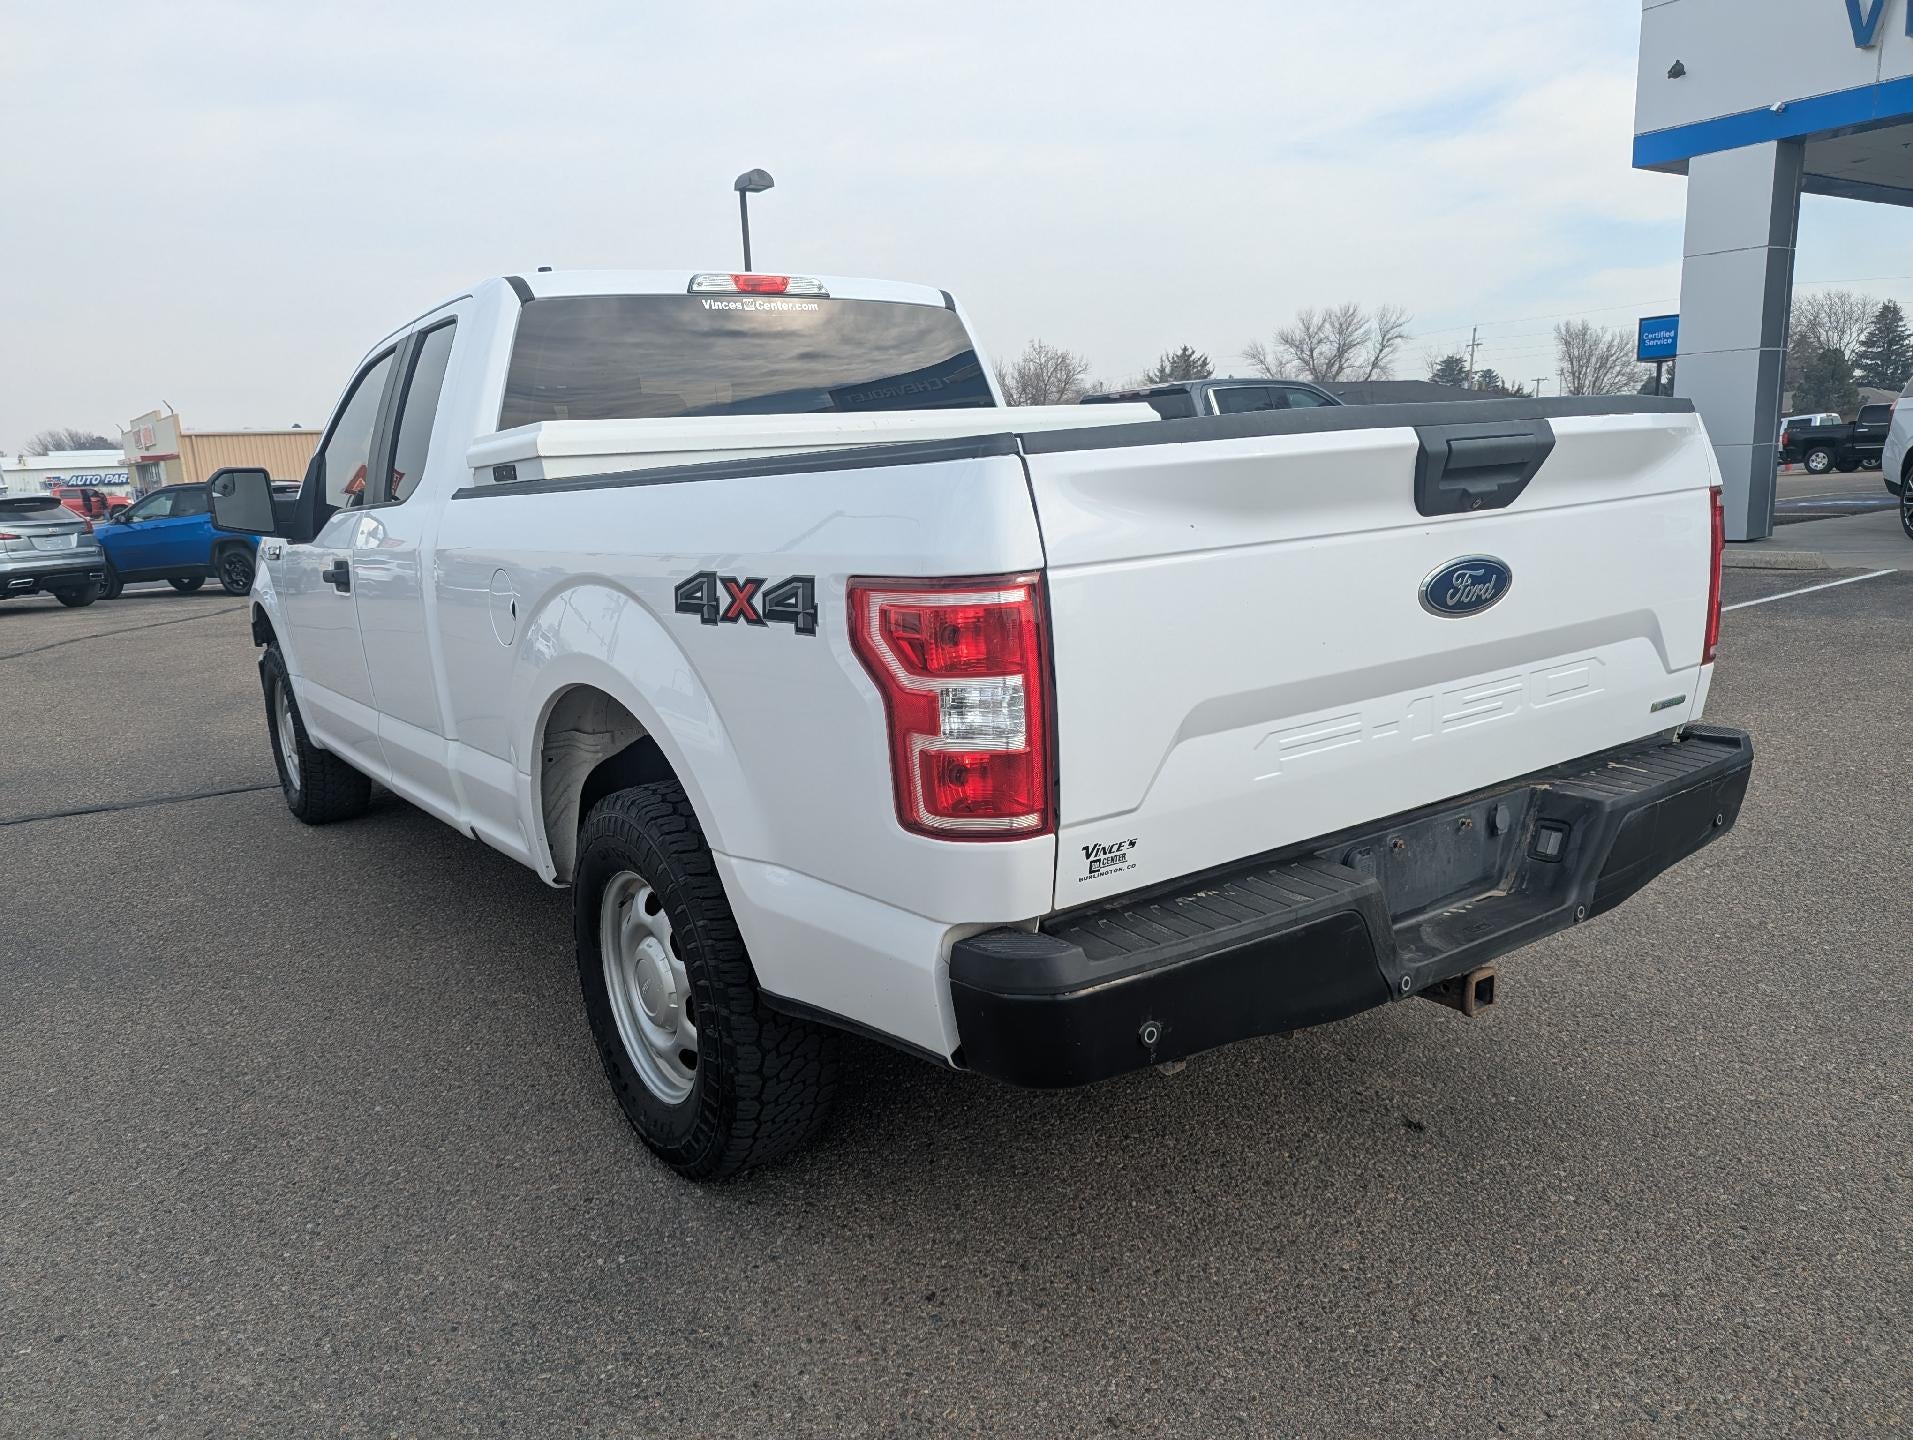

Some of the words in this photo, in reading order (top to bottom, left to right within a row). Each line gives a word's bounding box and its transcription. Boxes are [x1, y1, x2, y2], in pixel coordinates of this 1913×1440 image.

[1643, 330, 1675, 340] Certified
[1645, 338, 1673, 346] Service
[68, 475, 101, 486] AUTO
[1446, 569, 1497, 606] Ford
[1254, 656, 1606, 781] F-150
[1102, 853, 1127, 866] CENTER
